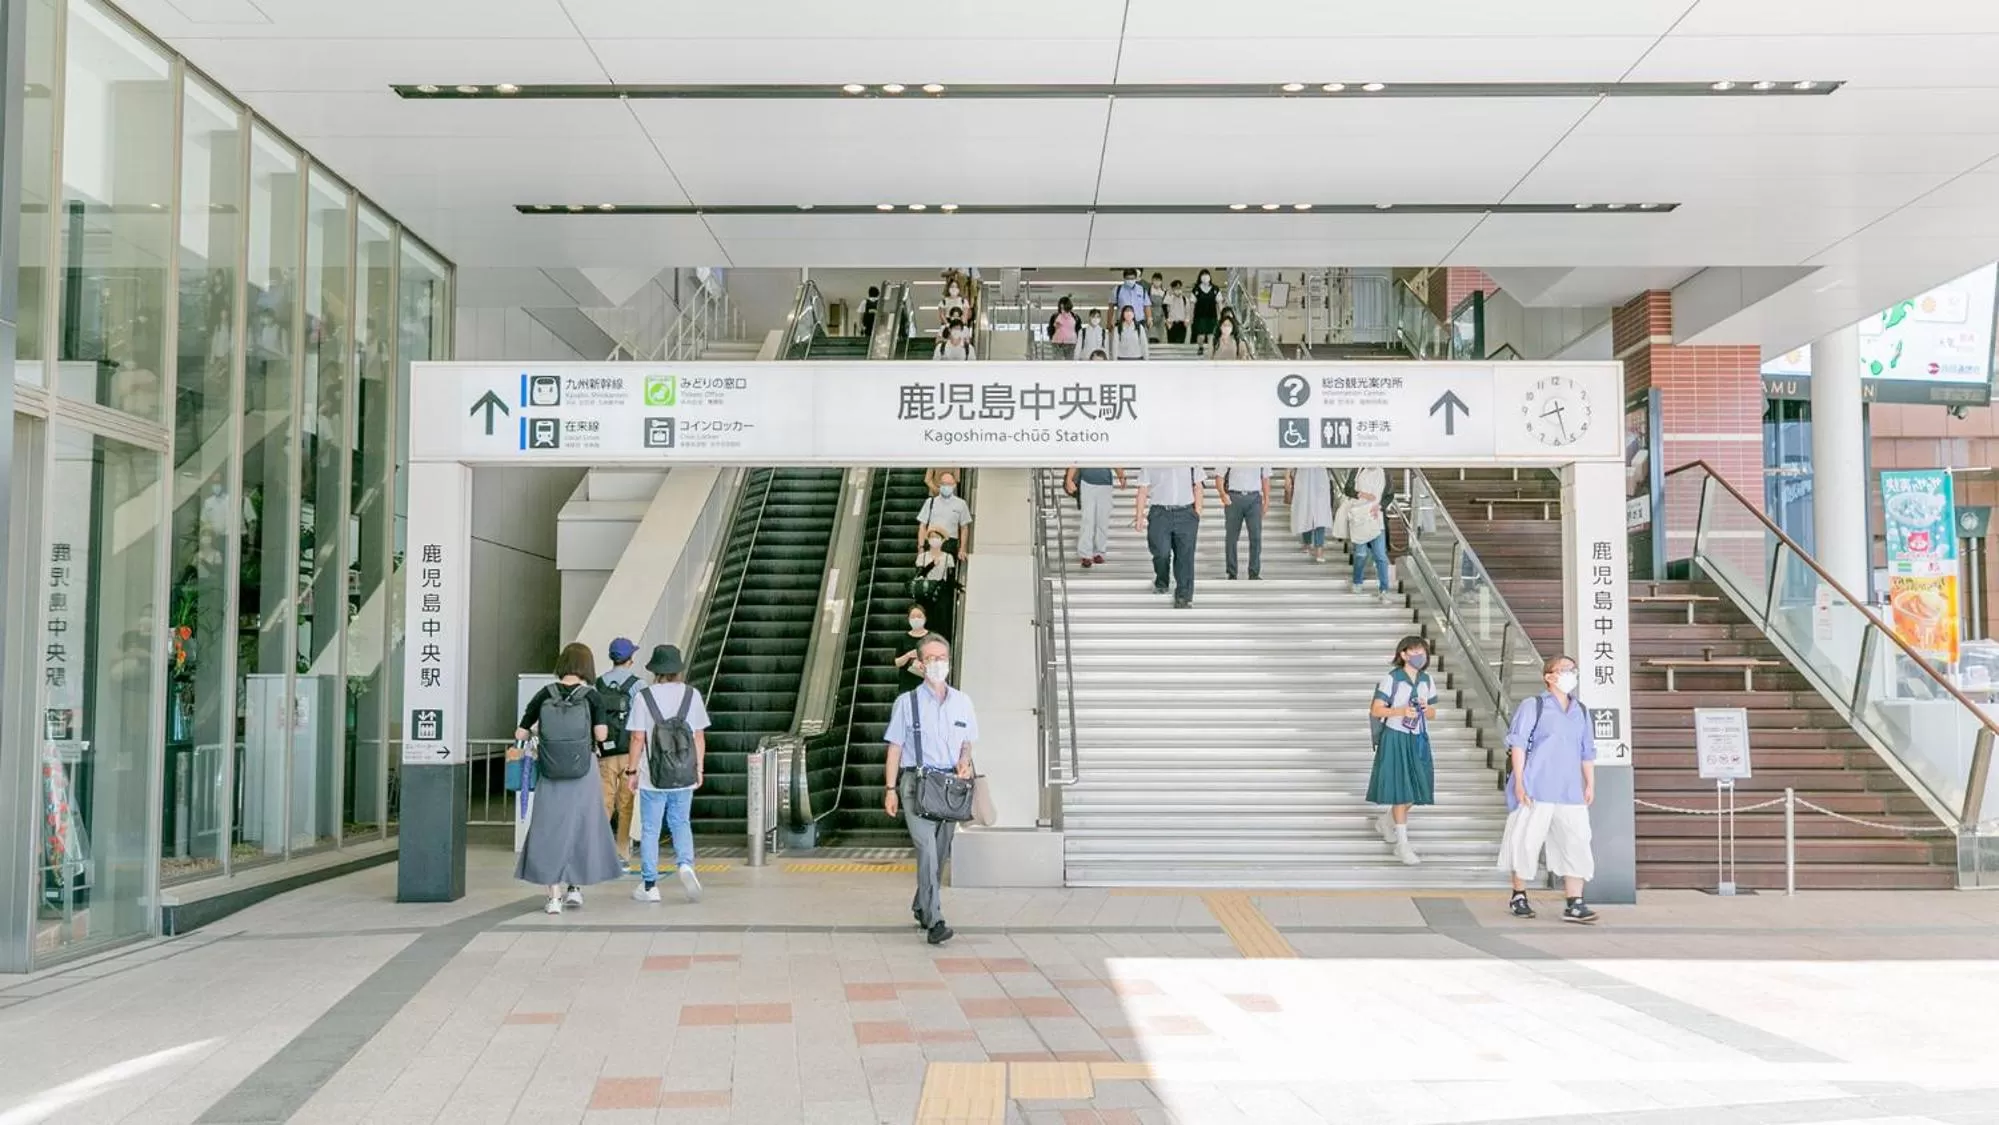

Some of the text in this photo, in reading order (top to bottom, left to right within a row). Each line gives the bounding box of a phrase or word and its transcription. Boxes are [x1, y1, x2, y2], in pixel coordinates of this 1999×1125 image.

[565, 378, 624, 390] 九州新幹線
[680, 378, 747, 389] みどりの窓口
[1321, 377, 1403, 389] 総合観光案内所
[1537, 381, 1544, 389] 11
[1551, 376, 1560, 385] 12
[1569, 379, 1573, 388] 1
[1526, 392, 1534, 401] 10
[1580, 390, 1586, 400] 2
[898, 382, 1138, 421] 鹿児島中央駅
[1522, 406, 1528, 416] 9
[1586, 406, 1591, 416] 3
[565, 421, 600, 432] 在来線
[680, 420, 755, 431] コインロッカー
[1356, 420, 1391, 432] お手洗
[1526, 422, 1532, 432] 8
[1581, 422, 1587, 430] 4
[924, 428, 1110, 446] Kagoshima-chūō Station
[1540, 433, 1545, 442] 7
[1554, 438, 1560, 446] 6
[1570, 433, 1576, 442] 5
[420, 544, 442, 687] 鹿児島中央駅
[1592, 541, 1614, 685] 鹿児島中央駅
